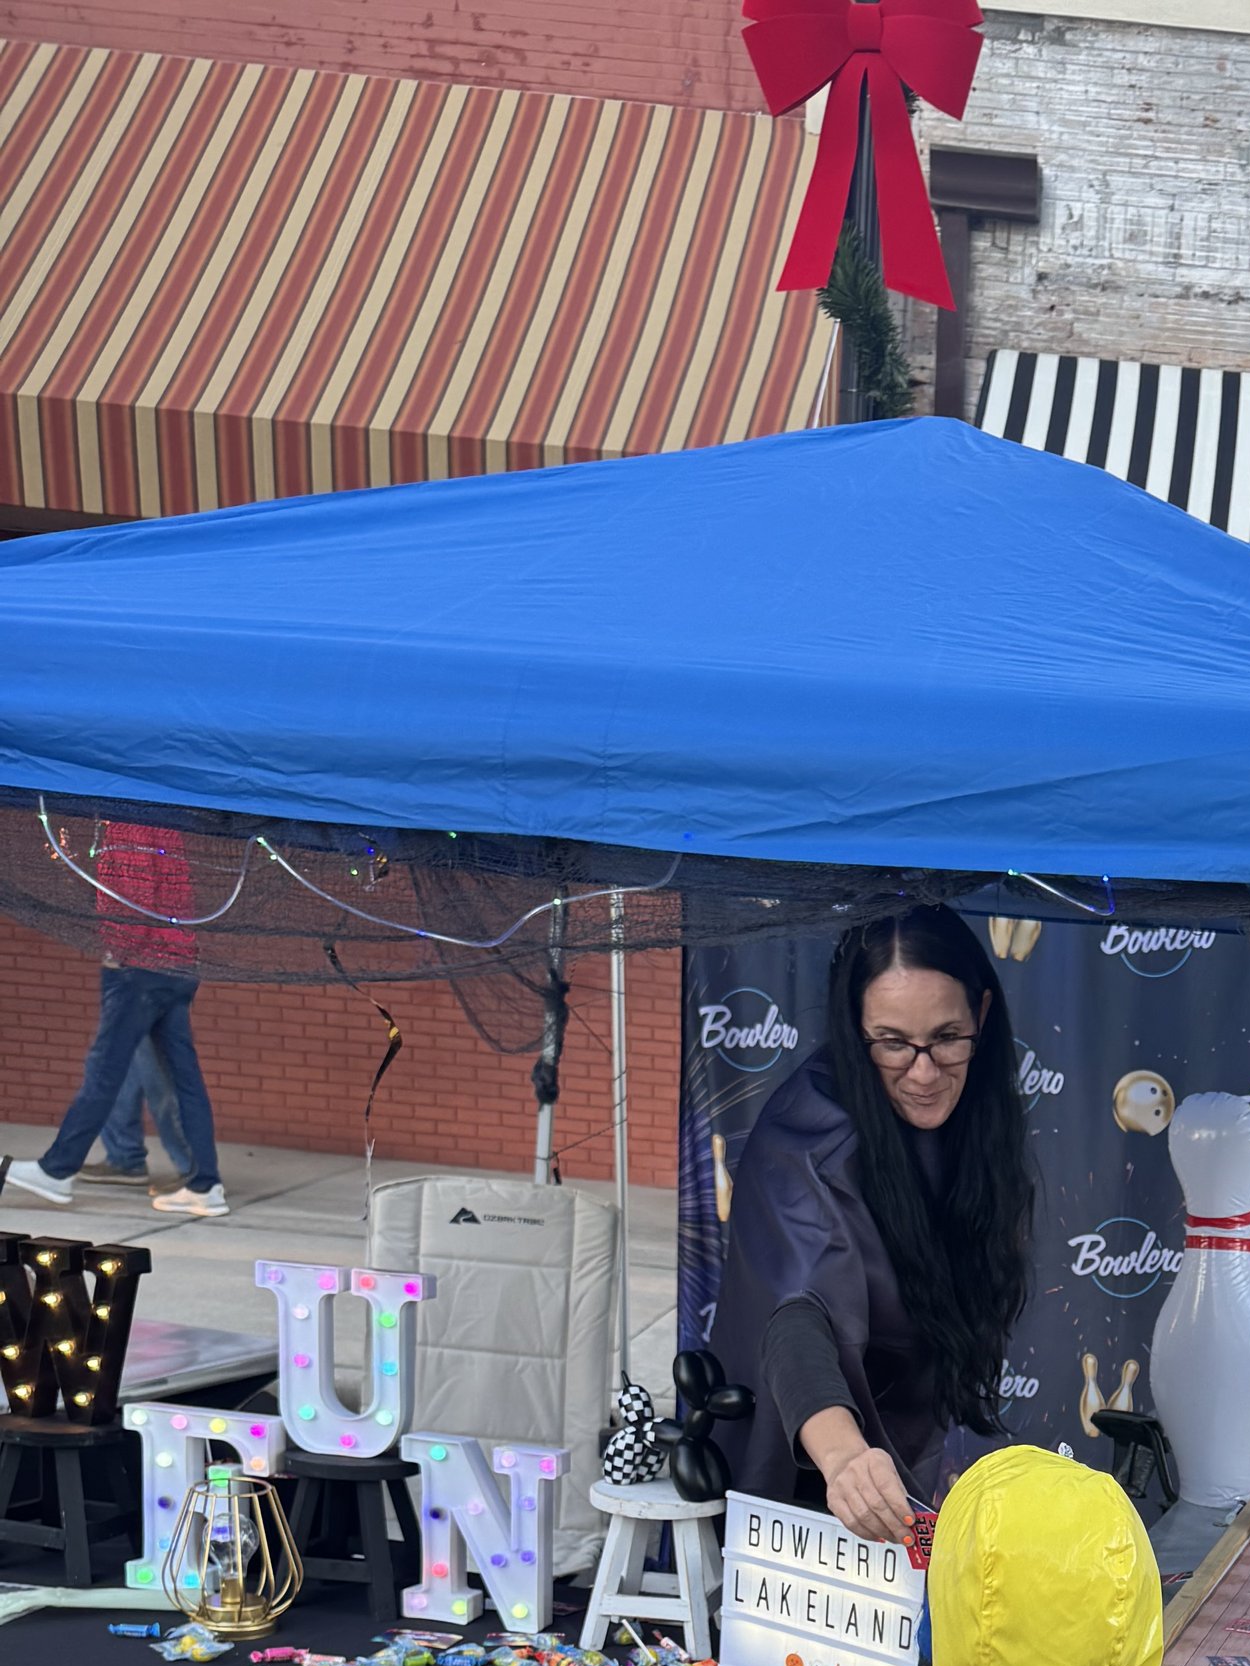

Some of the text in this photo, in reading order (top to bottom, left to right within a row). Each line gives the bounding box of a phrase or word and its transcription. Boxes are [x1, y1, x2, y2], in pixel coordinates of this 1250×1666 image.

[699, 1004, 798, 1050] Bowlero
[1019, 1050, 1064, 1096] lero
[1067, 1231, 1185, 1277] Bowlero
[748, 1513, 897, 1583] BOWLERO
[734, 1568, 913, 1650] LAKELAND
